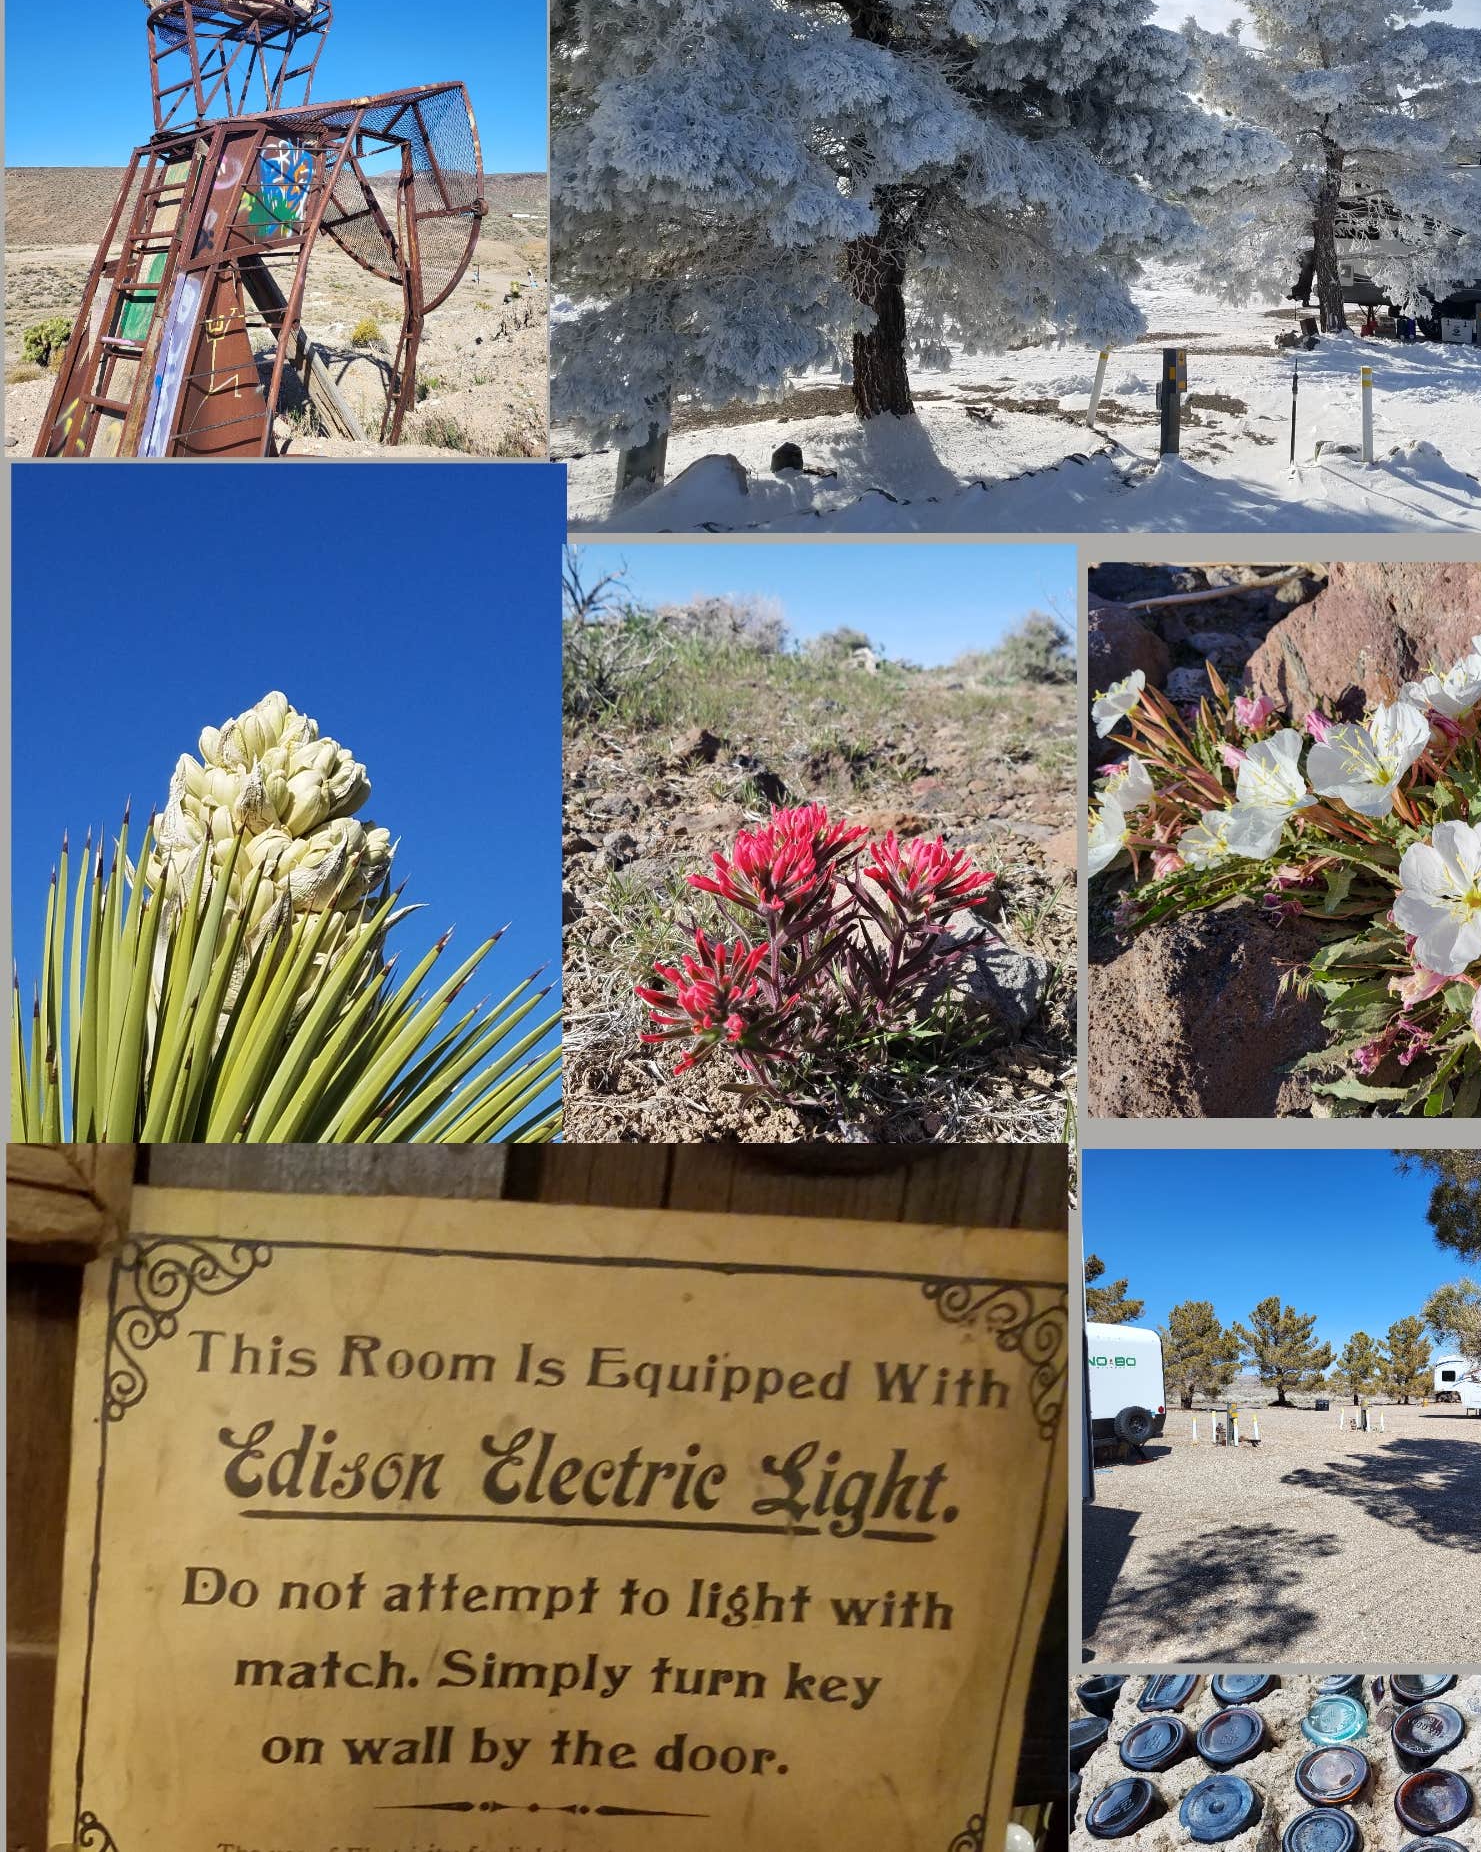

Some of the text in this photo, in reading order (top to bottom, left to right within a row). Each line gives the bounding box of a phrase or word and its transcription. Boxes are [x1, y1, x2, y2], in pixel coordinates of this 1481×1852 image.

[188, 1328, 1011, 1409] This Room Is Equipped With
[217, 1419, 961, 1539] Edison Electric Light.
[181, 1565, 954, 1632] Do not attempt to light with
[233, 1647, 882, 1710] match. Simply turn key
[260, 1726, 790, 1777] on wall by the door.
